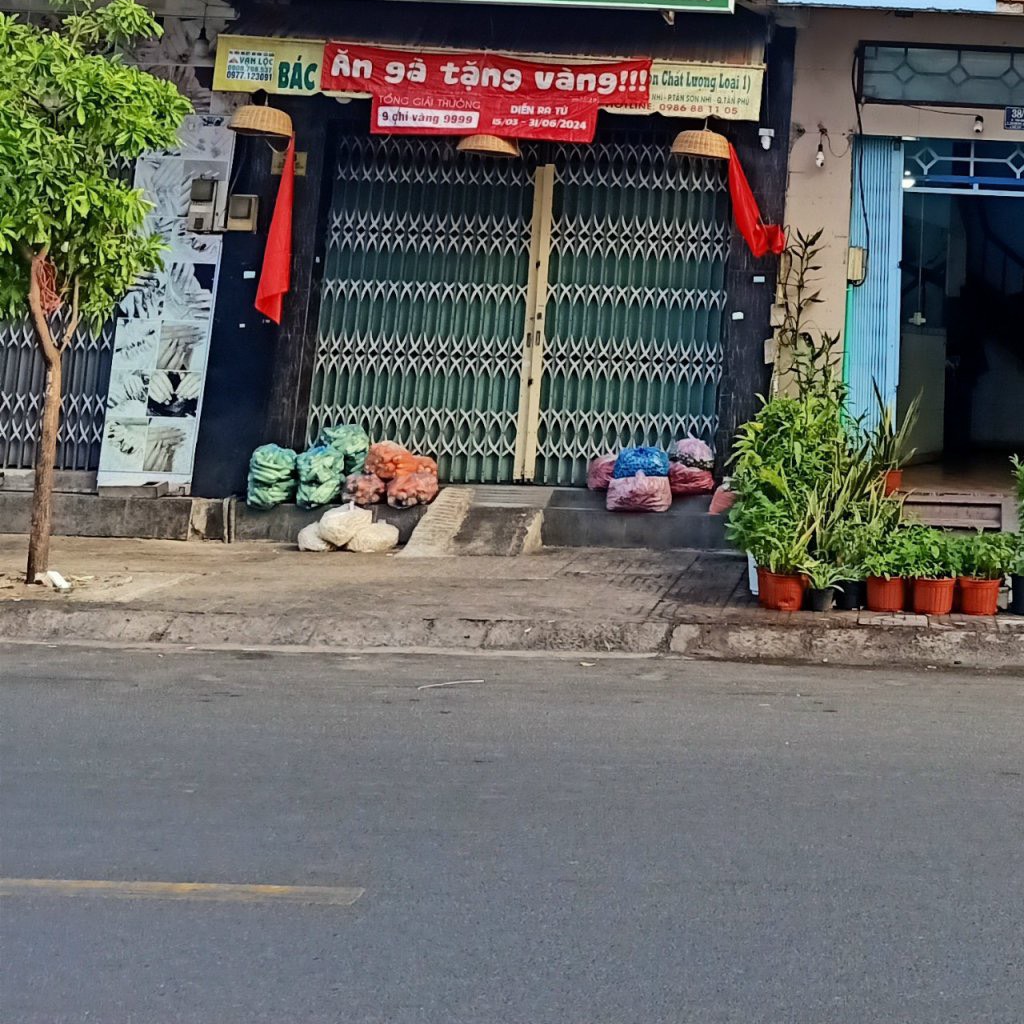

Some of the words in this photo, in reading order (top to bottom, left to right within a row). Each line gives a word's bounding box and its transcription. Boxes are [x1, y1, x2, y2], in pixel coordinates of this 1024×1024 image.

[278, 55, 318, 91] BÁC
[331, 49, 373, 79] Ăn
[384, 57, 427, 84] gà
[440, 60, 522, 92] tặng
[534, 67, 648, 94] vàng!!!
[661, 70, 683, 87] Chất
[686, 72, 716, 93] Lượng
[382, 111, 388, 121] 9
[443, 114, 473, 125] 9999
